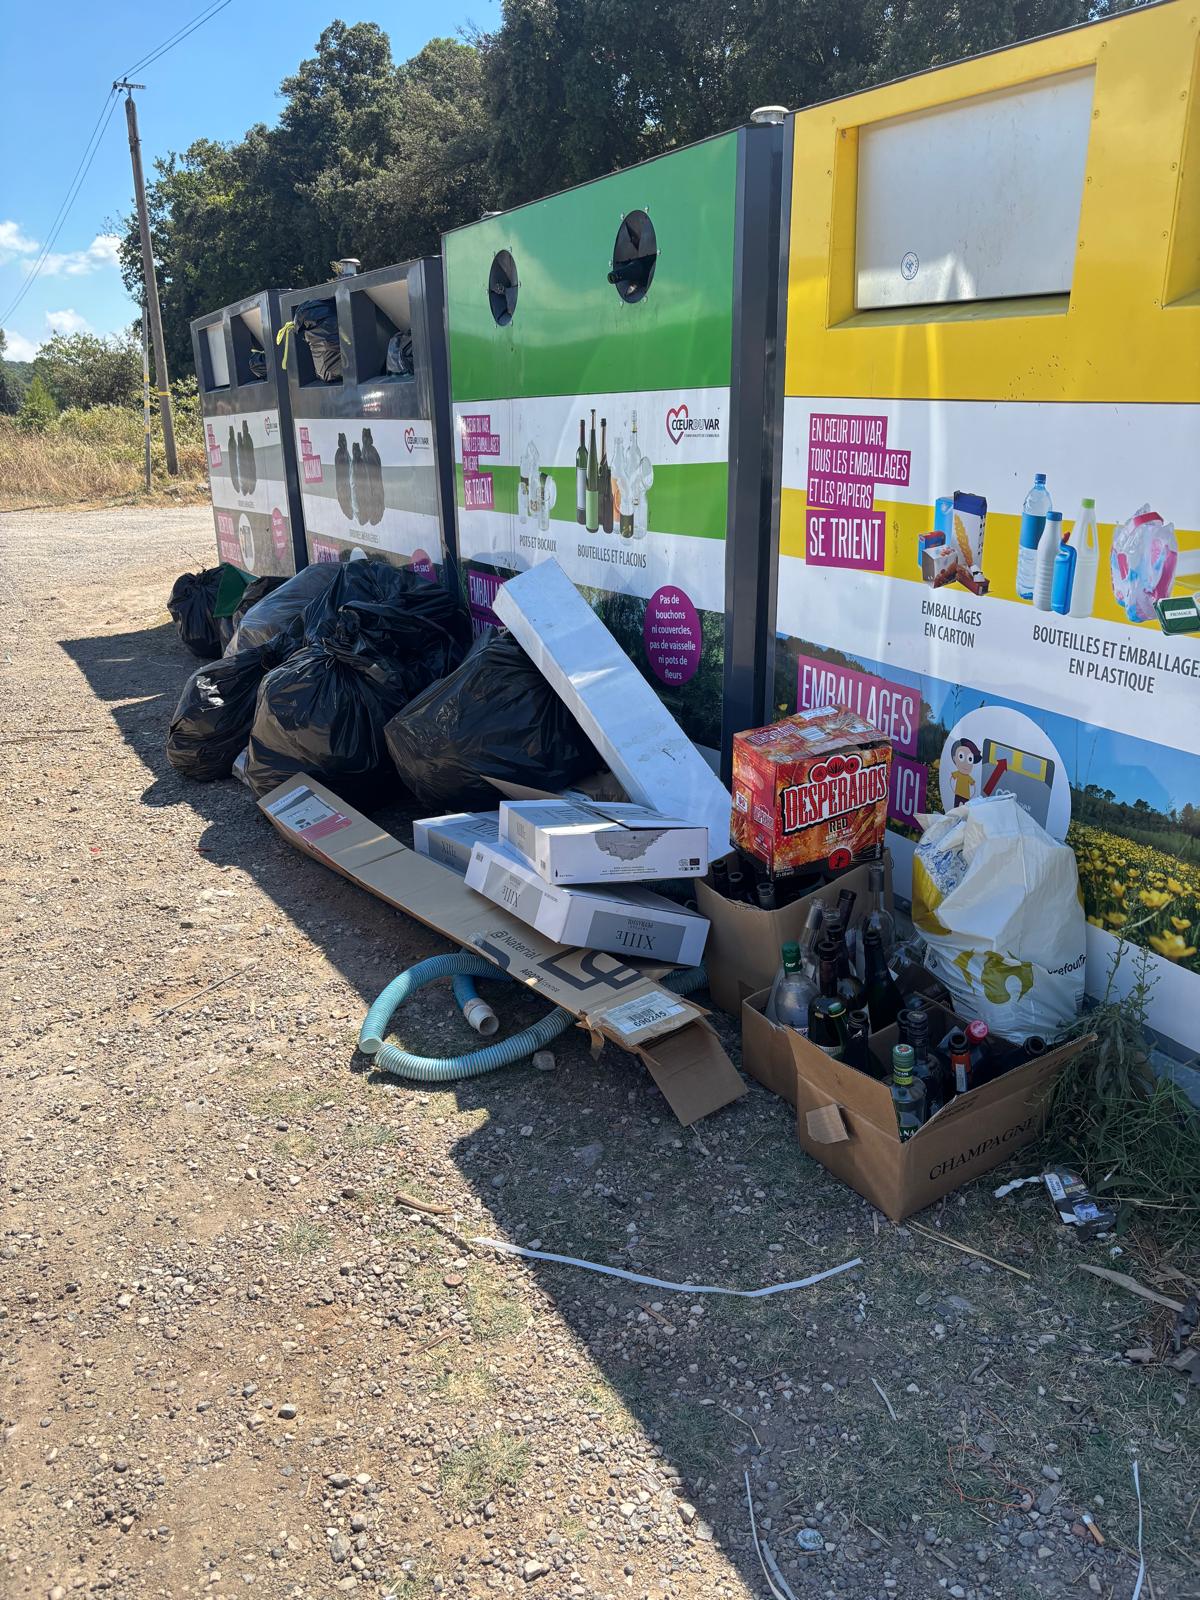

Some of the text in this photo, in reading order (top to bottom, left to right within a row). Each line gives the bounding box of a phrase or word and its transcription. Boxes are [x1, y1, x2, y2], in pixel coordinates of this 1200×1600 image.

[477, 437, 500, 452] EMBALLAGES
[812, 417, 884, 447] EN CŒUR DU VAR,
[811, 447, 908, 481] TOUS LES EMBALLAGES
[465, 477, 492, 505] SE TRIENT
[809, 477, 872, 510] ET LES PAPIERS
[519, 534, 557, 552] POTS ET BOCAUX
[810, 516, 881, 562] SE TRIENT
[577, 543, 647, 569] BOUTEILLES ET FLACONS
[660, 594, 680, 605] Pas de
[655, 609, 686, 620] bouchons
[921, 600, 982, 627] EMBALLAGES
[651, 624, 692, 636] ni couvercles,
[924, 622, 975, 649] EN CARTON
[649, 639, 696, 651] pas de vaisselle
[1033, 624, 1200, 679] BOUTEILLES ET EMBALLAGE
[658, 654, 688, 666] ni pots de
[665, 669, 682, 680] fleurs
[1069, 658, 1155, 694] EN PLASTIQUE
[783, 764, 889, 832] DESPERADOS
[895, 765, 920, 816] ICI
[502, 935, 541, 960] Naterial
[633, 1010, 667, 1028] 690245
